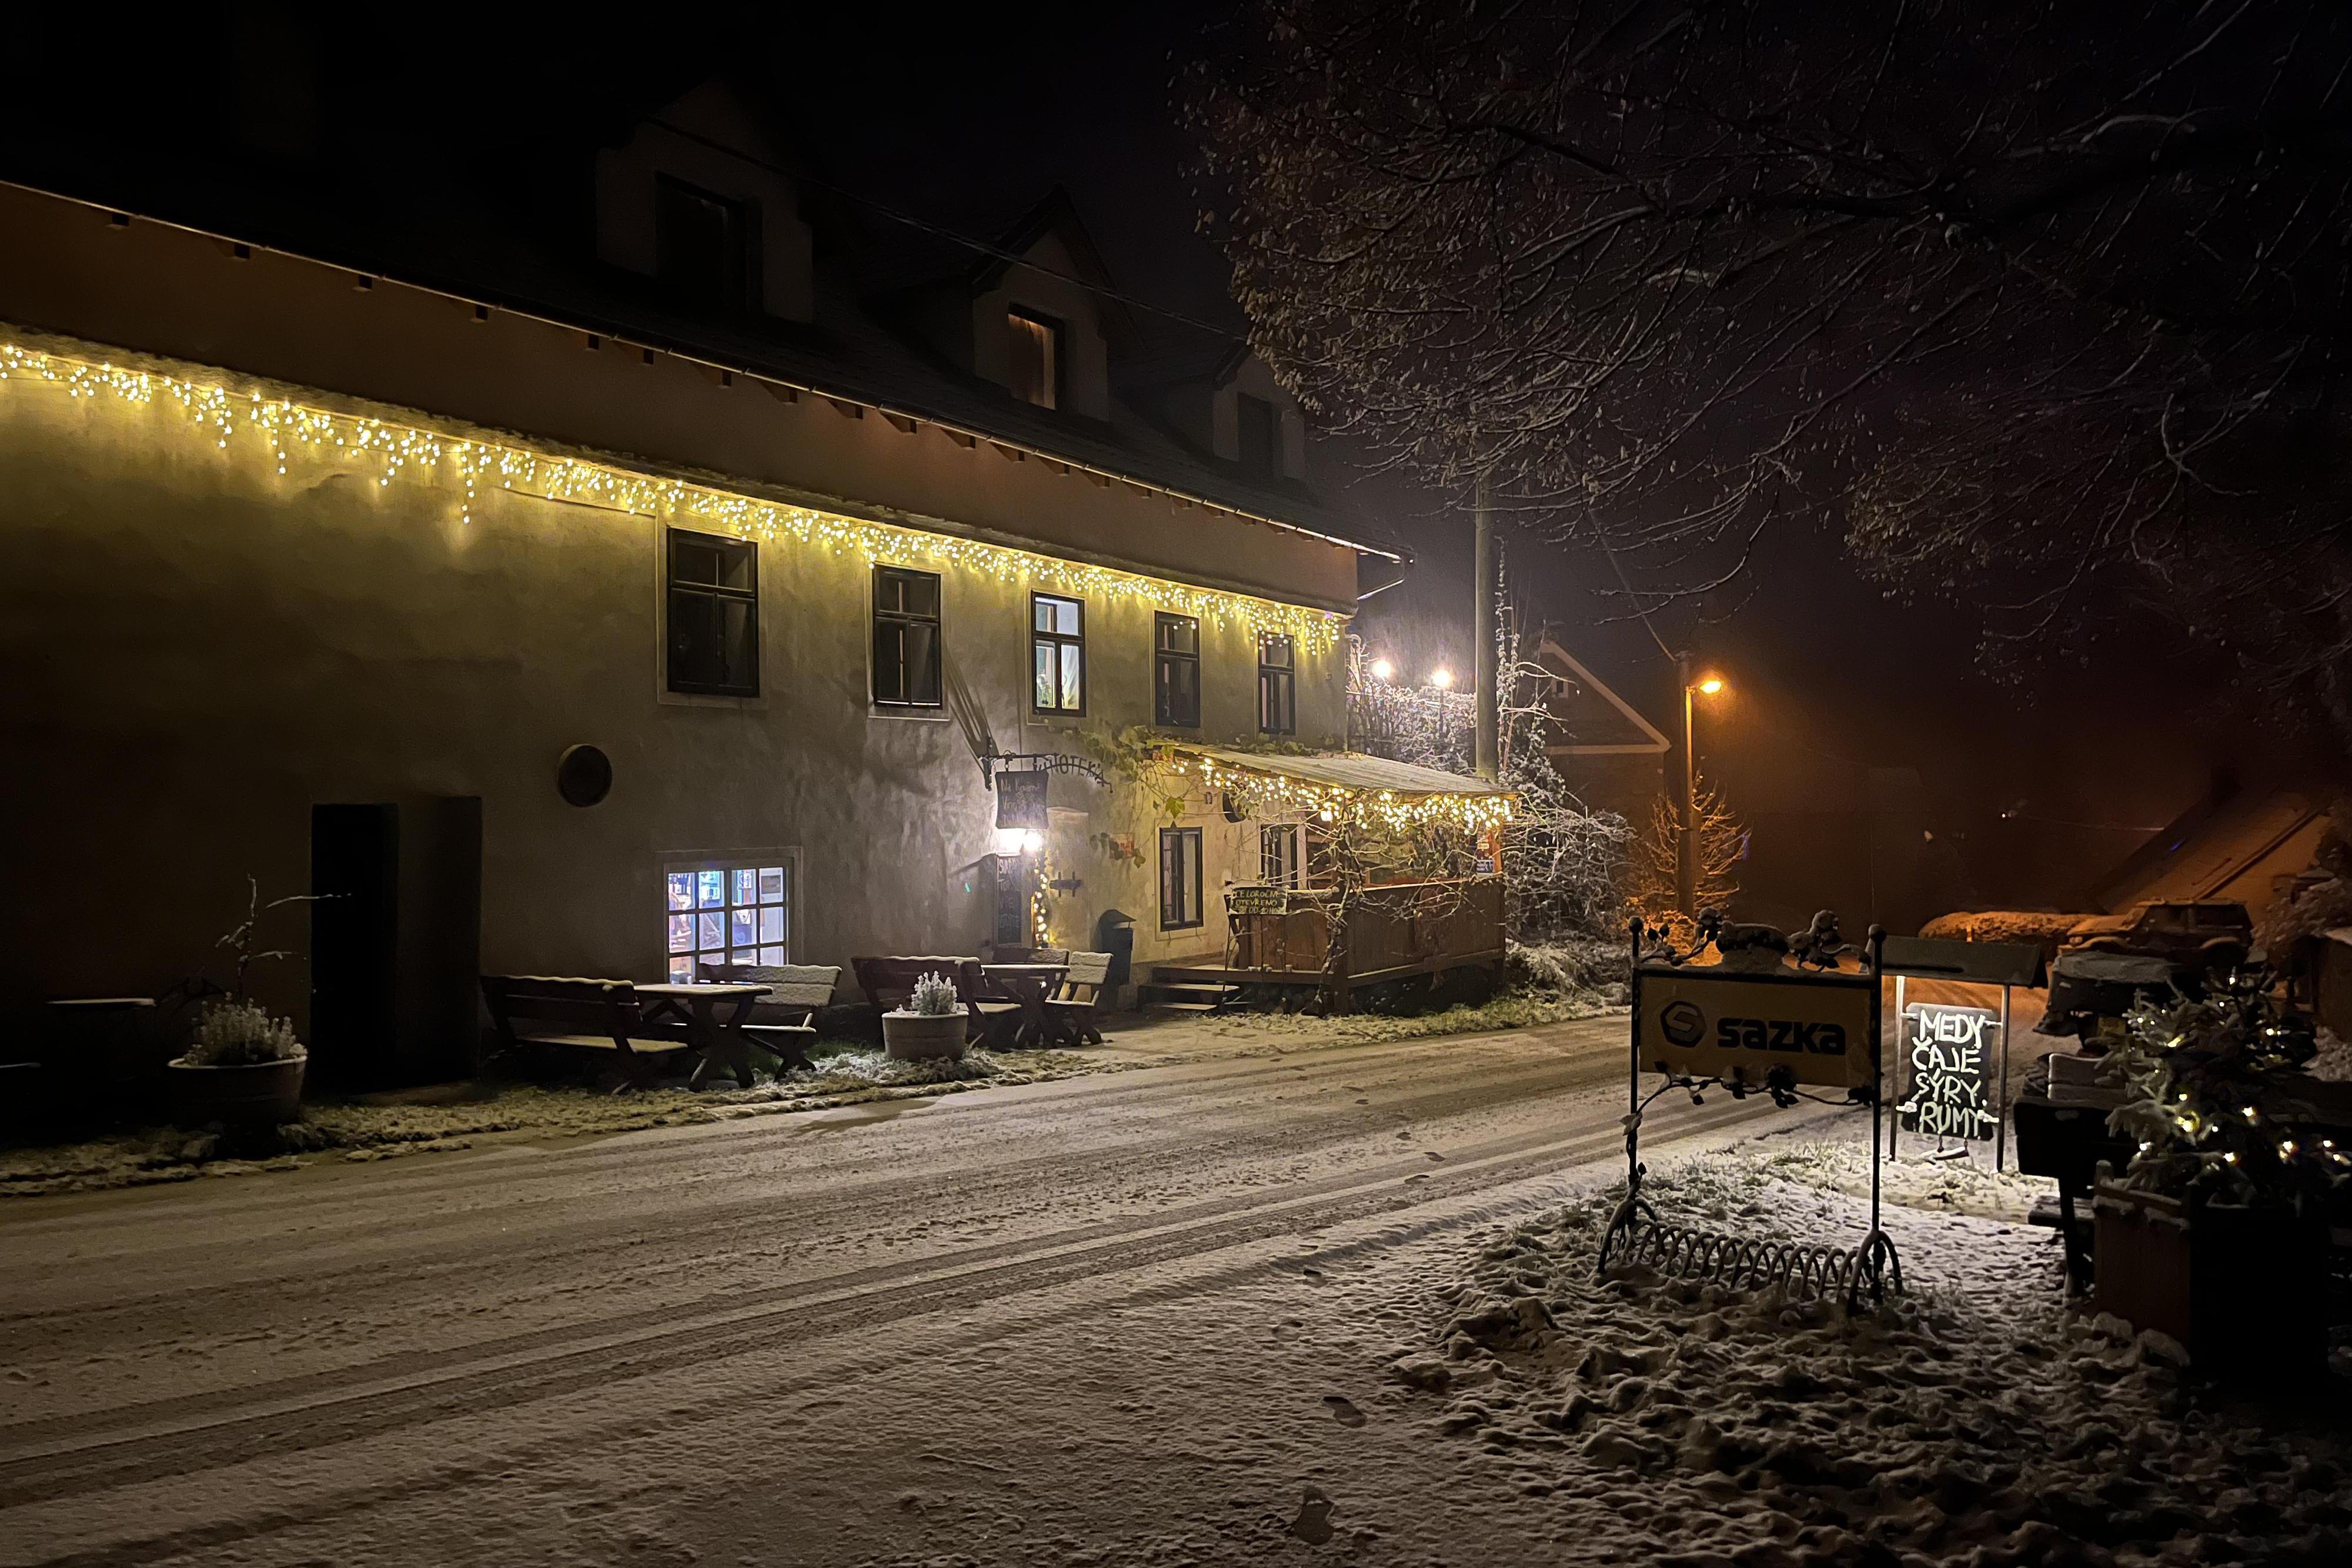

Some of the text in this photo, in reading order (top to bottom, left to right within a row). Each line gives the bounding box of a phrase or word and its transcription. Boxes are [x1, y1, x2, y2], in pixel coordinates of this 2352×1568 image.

[1919, 1009, 1986, 1048] MEDY
[1912, 1036, 1982, 1074] ČAJE
[1910, 1068, 1982, 1107] SÝRY
[1919, 1101, 1982, 1138] RUMY
